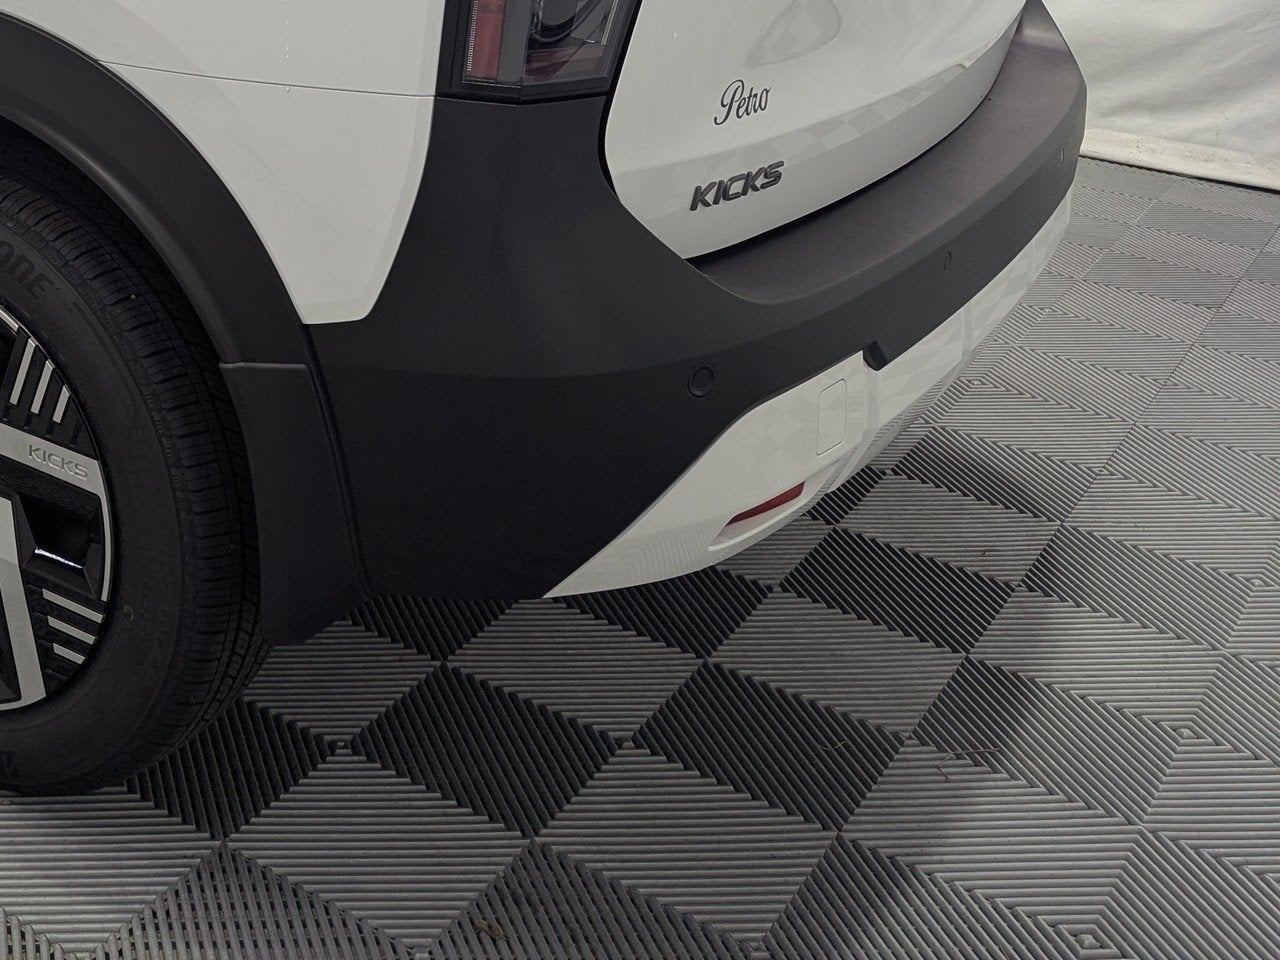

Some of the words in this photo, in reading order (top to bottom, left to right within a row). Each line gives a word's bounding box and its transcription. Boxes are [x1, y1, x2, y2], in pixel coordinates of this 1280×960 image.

[714, 79, 771, 125] Petro
[689, 160, 785, 211] KICKS
[28, 443, 88, 480] KICKS
